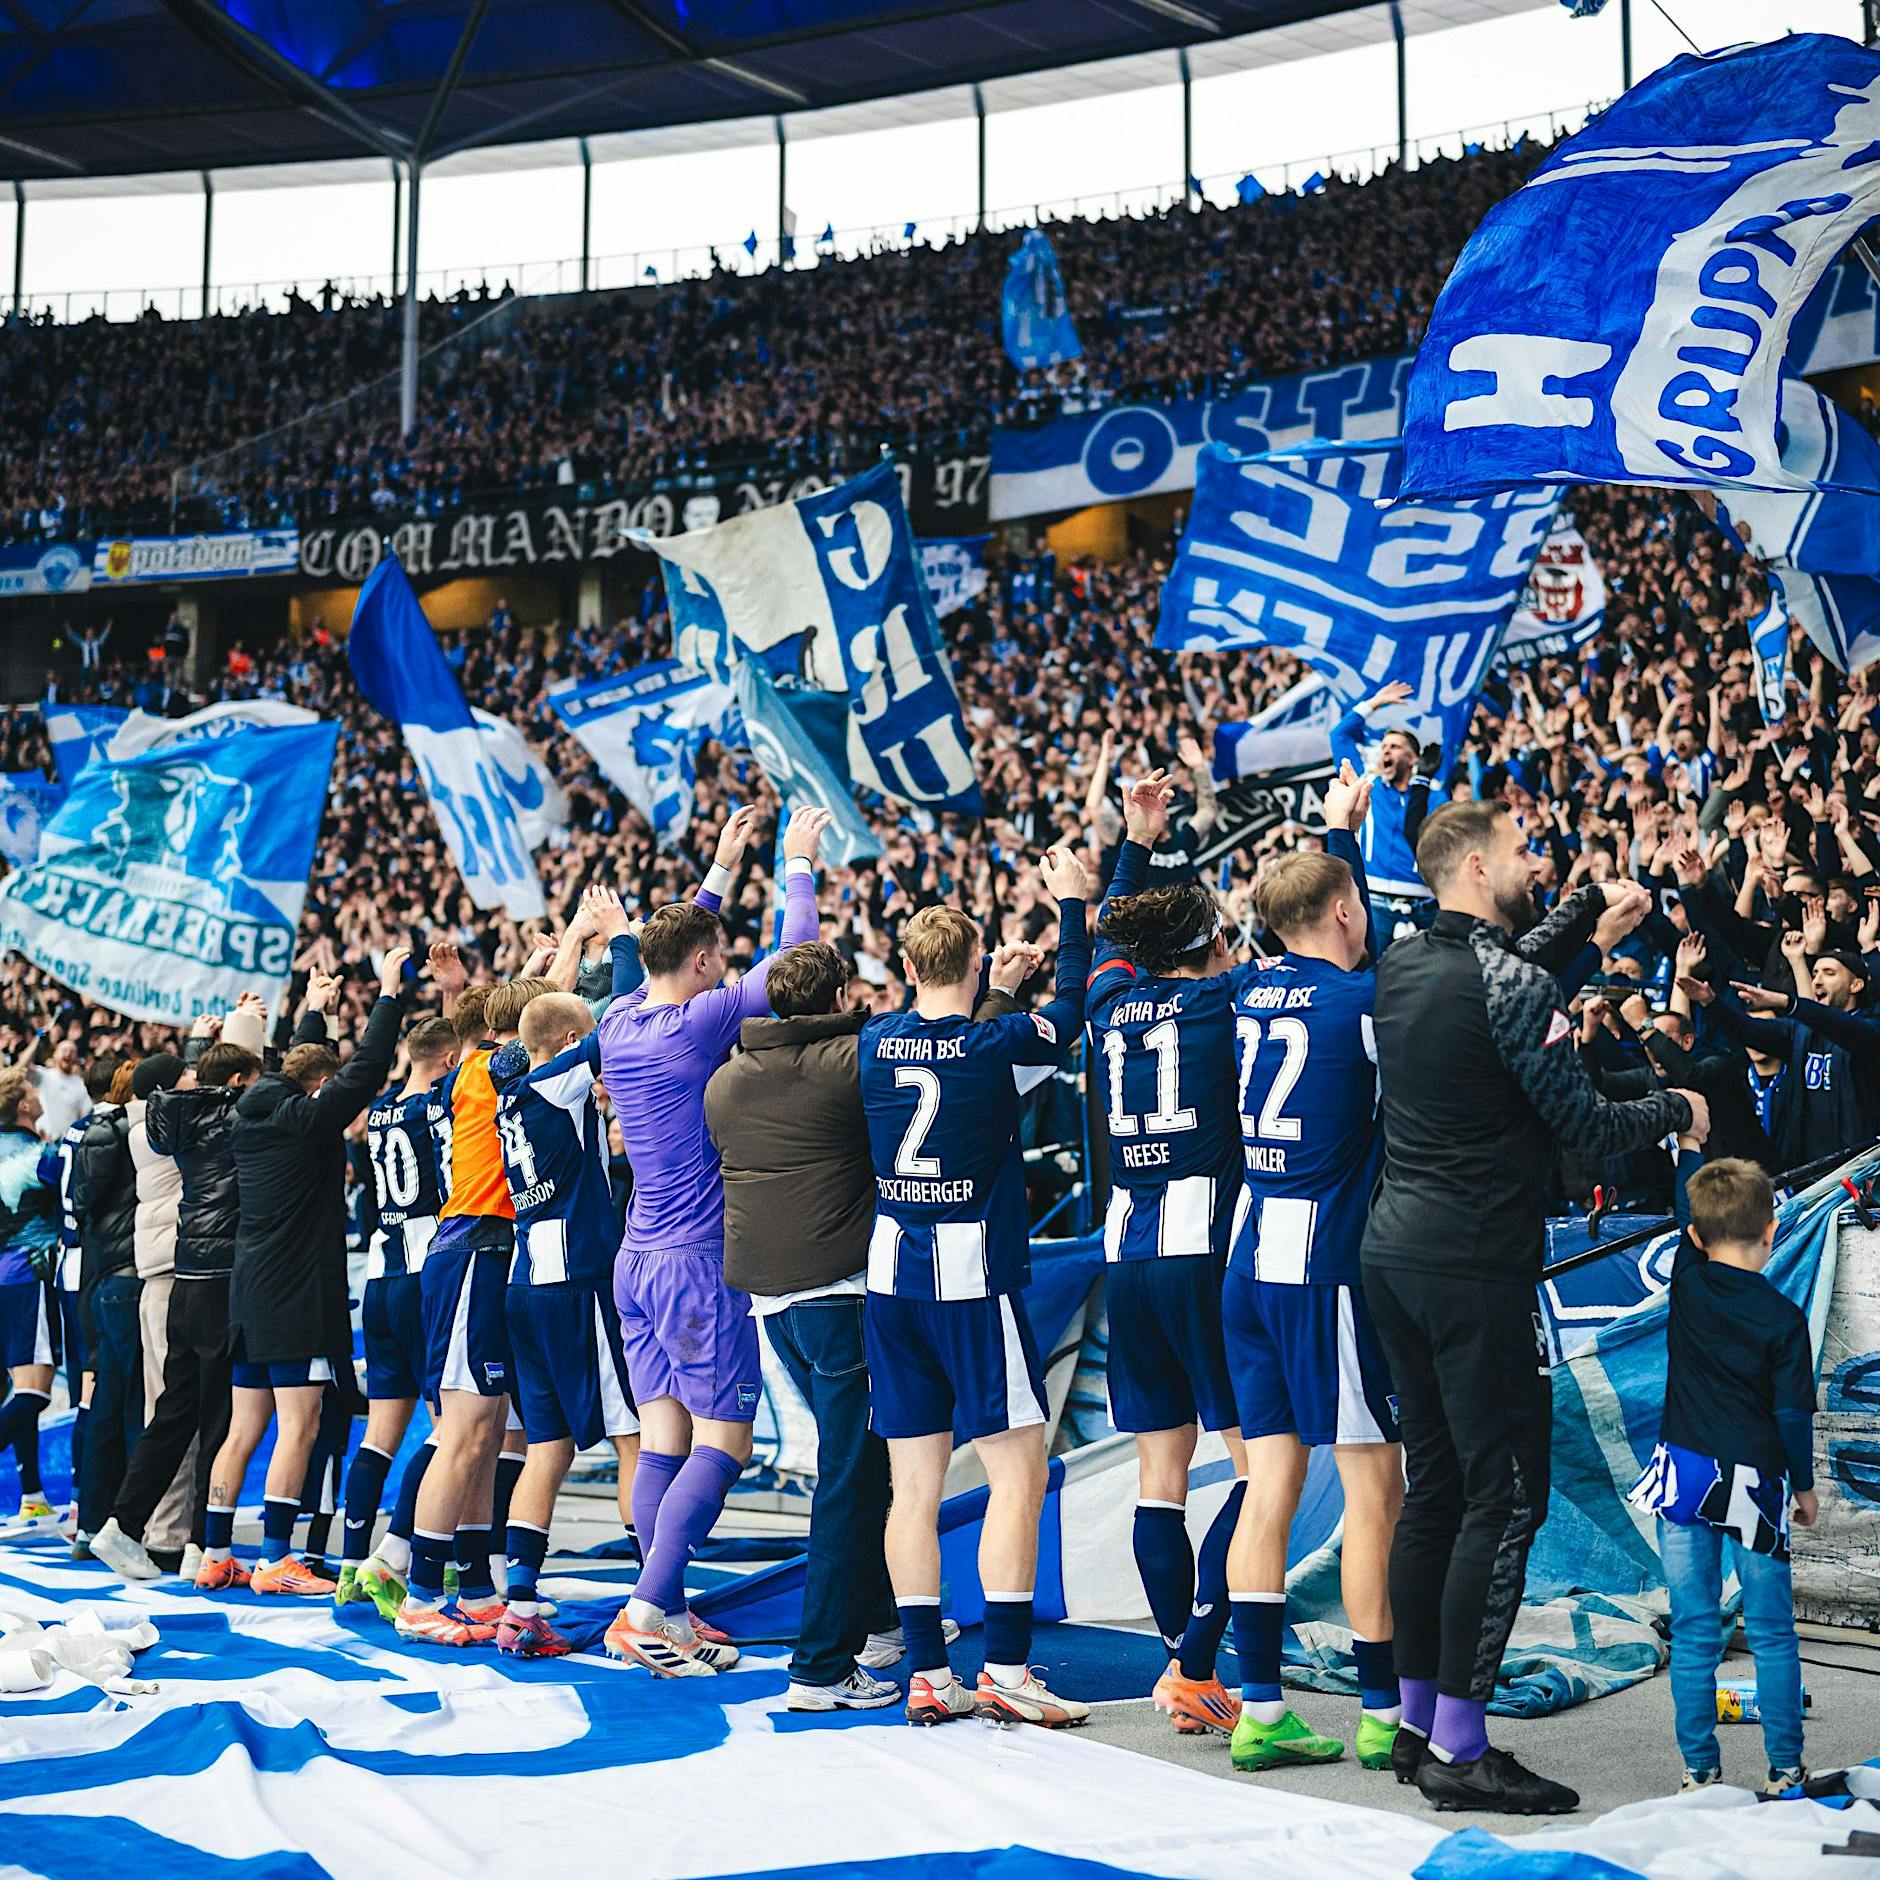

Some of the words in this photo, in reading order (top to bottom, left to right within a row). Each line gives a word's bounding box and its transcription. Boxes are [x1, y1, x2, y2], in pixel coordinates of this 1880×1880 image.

[876, 1037, 933, 1060] HERTHA
[936, 1035, 967, 1060] BSC
[1102, 1019, 1197, 1136] 11
[894, 1066, 941, 1177] 2
[1122, 1143, 1170, 1168] REESE
